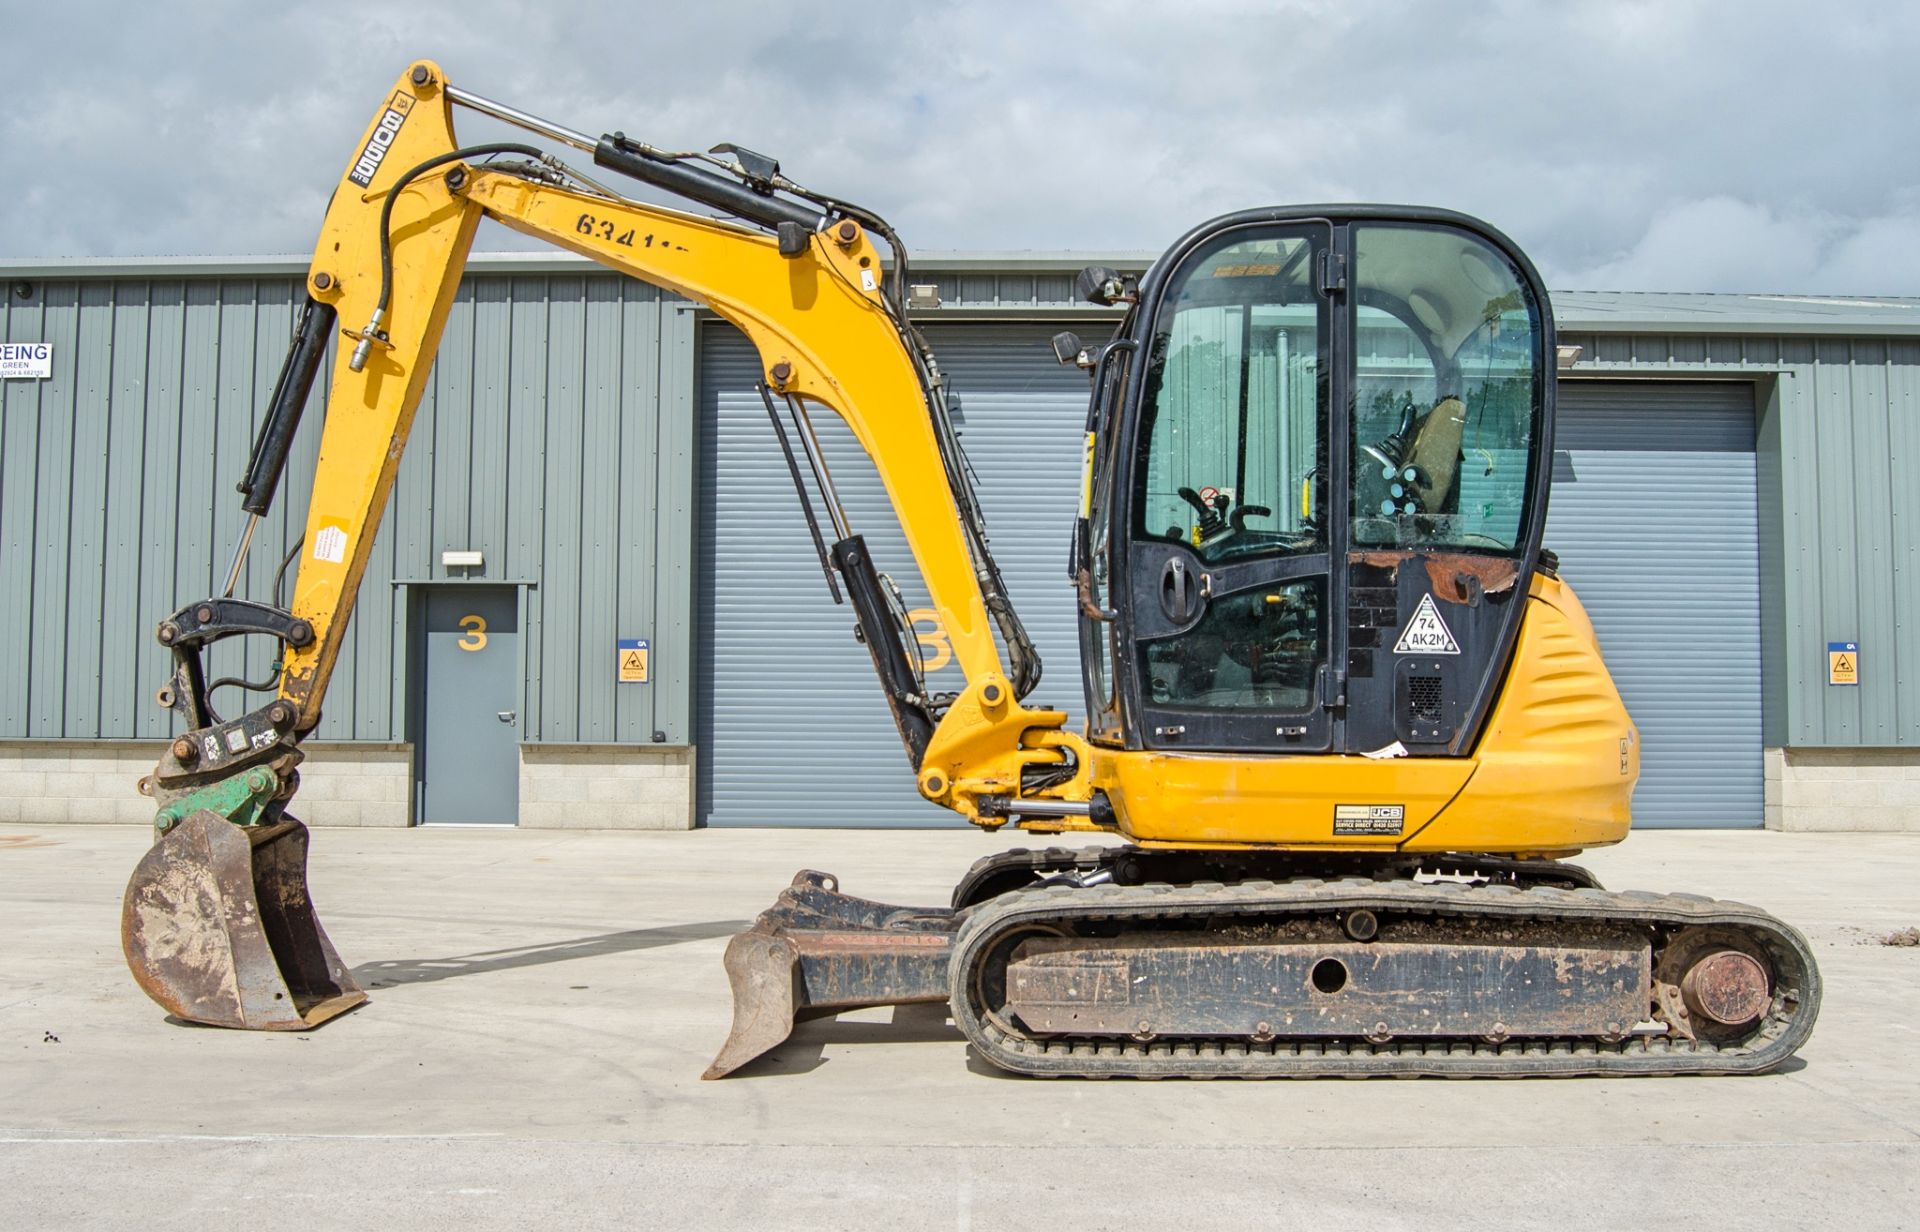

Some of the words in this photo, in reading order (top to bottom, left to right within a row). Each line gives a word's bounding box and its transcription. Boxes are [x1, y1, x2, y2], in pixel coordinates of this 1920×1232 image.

[355, 108, 404, 177] 8055
[0, 345, 47, 360] EING
[1420, 618, 1435, 630] 74
[458, 615, 487, 651] 3
[904, 608, 951, 672] 3
[1412, 633, 1445, 646] AK2M
[1372, 808, 1401, 817] JCB
